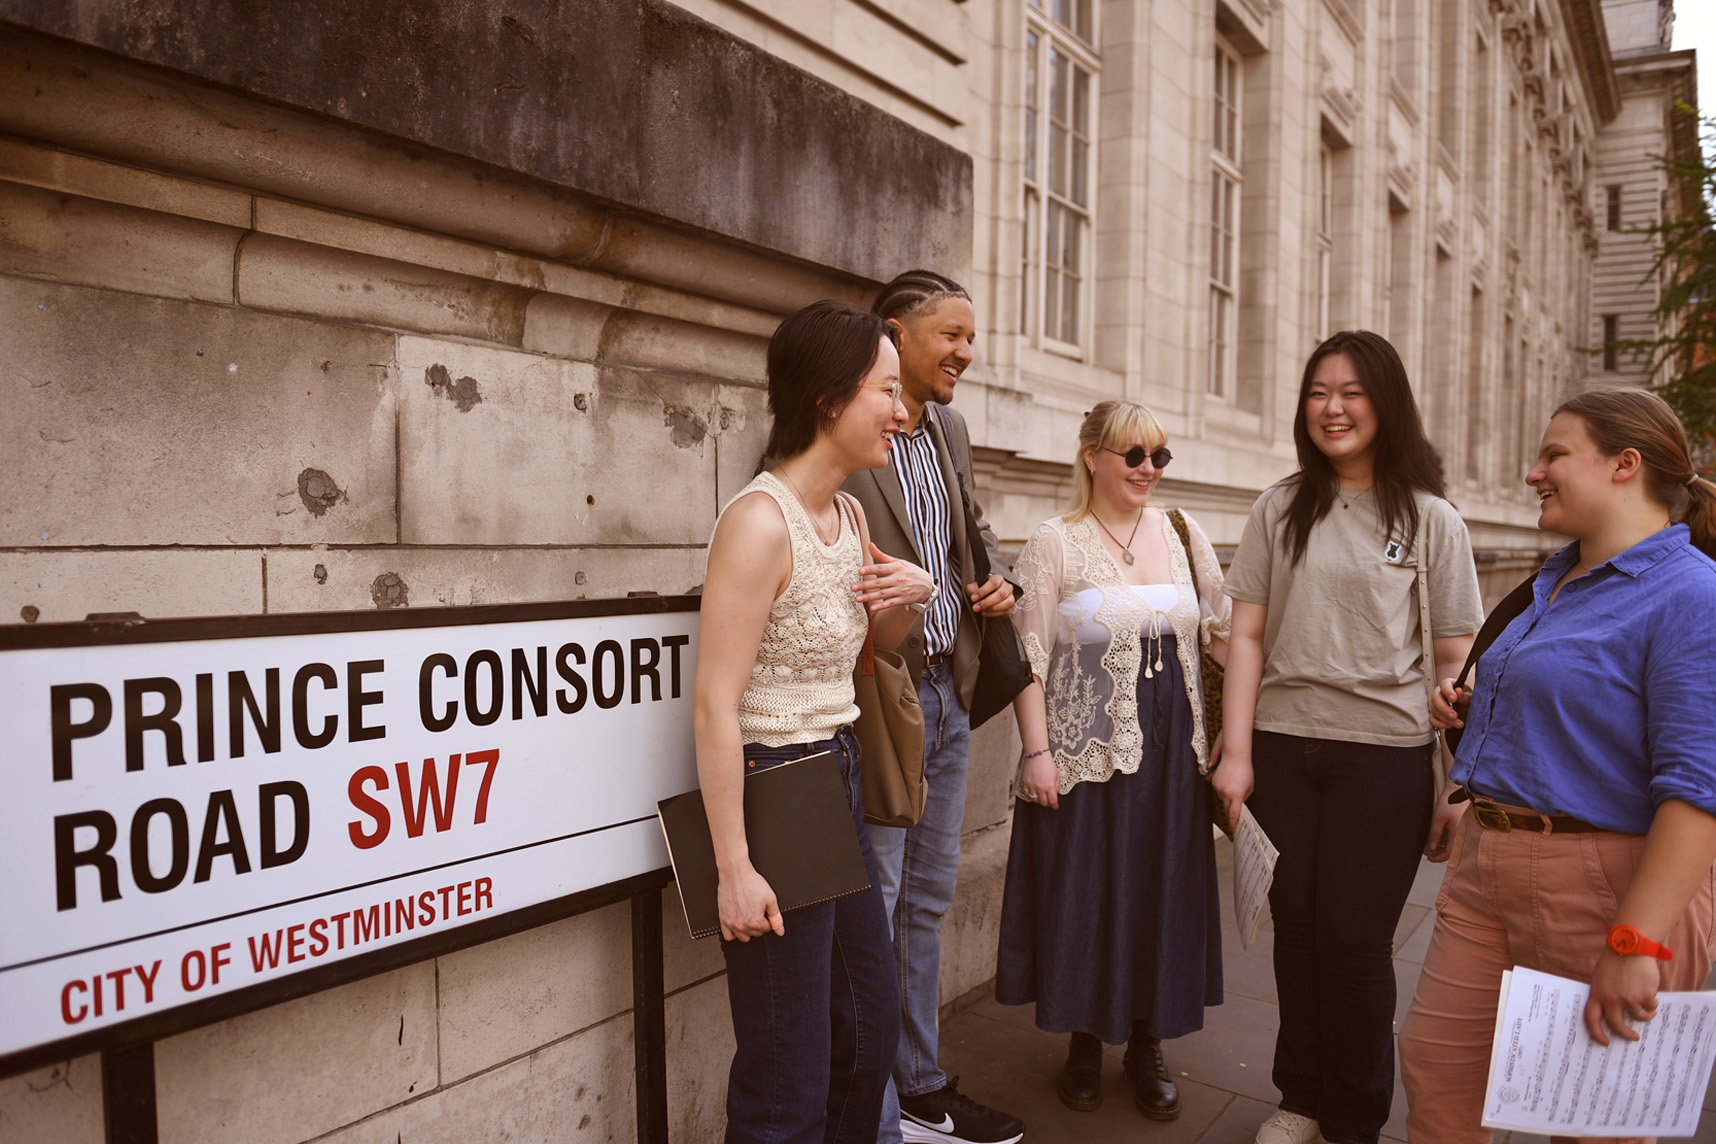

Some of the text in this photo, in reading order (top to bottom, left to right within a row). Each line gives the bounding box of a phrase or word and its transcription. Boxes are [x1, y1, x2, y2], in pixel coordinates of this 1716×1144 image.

[50, 635, 690, 782] PRINCE CONSORT
[54, 748, 500, 912] ROAD SW7
[60, 876, 493, 1025] CITY OF WESTMINSTER
[1506, 1035, 1520, 1082] SOPHISTICATED
